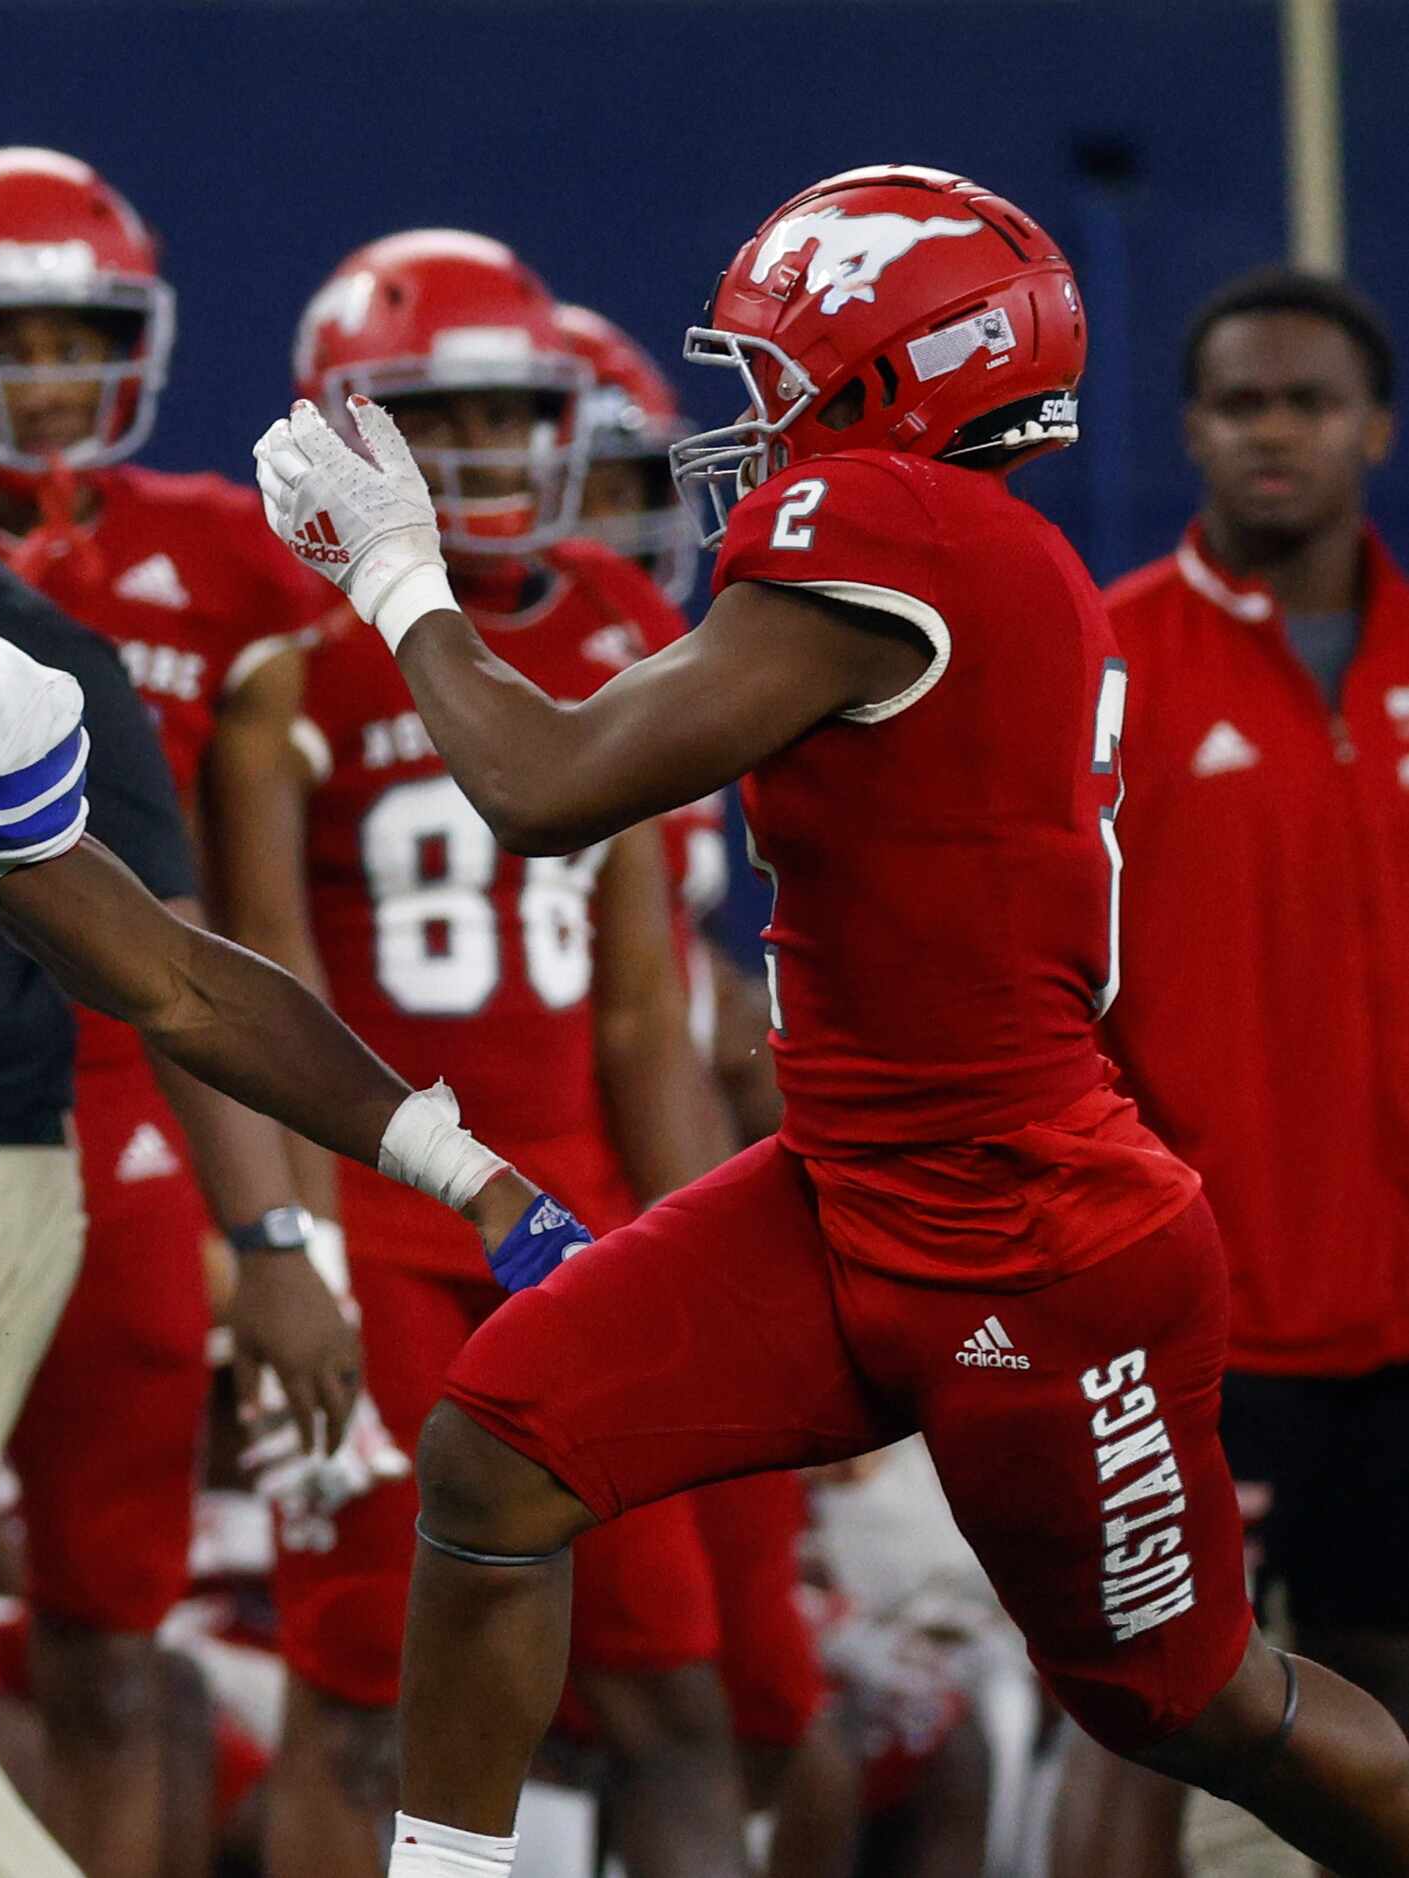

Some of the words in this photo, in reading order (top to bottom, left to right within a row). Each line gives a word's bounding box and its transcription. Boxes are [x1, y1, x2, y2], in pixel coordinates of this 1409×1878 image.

[769, 476, 829, 551] 2
[954, 1347, 1031, 1370] adidas
[1079, 1348, 1197, 1642] MUSTANGS
